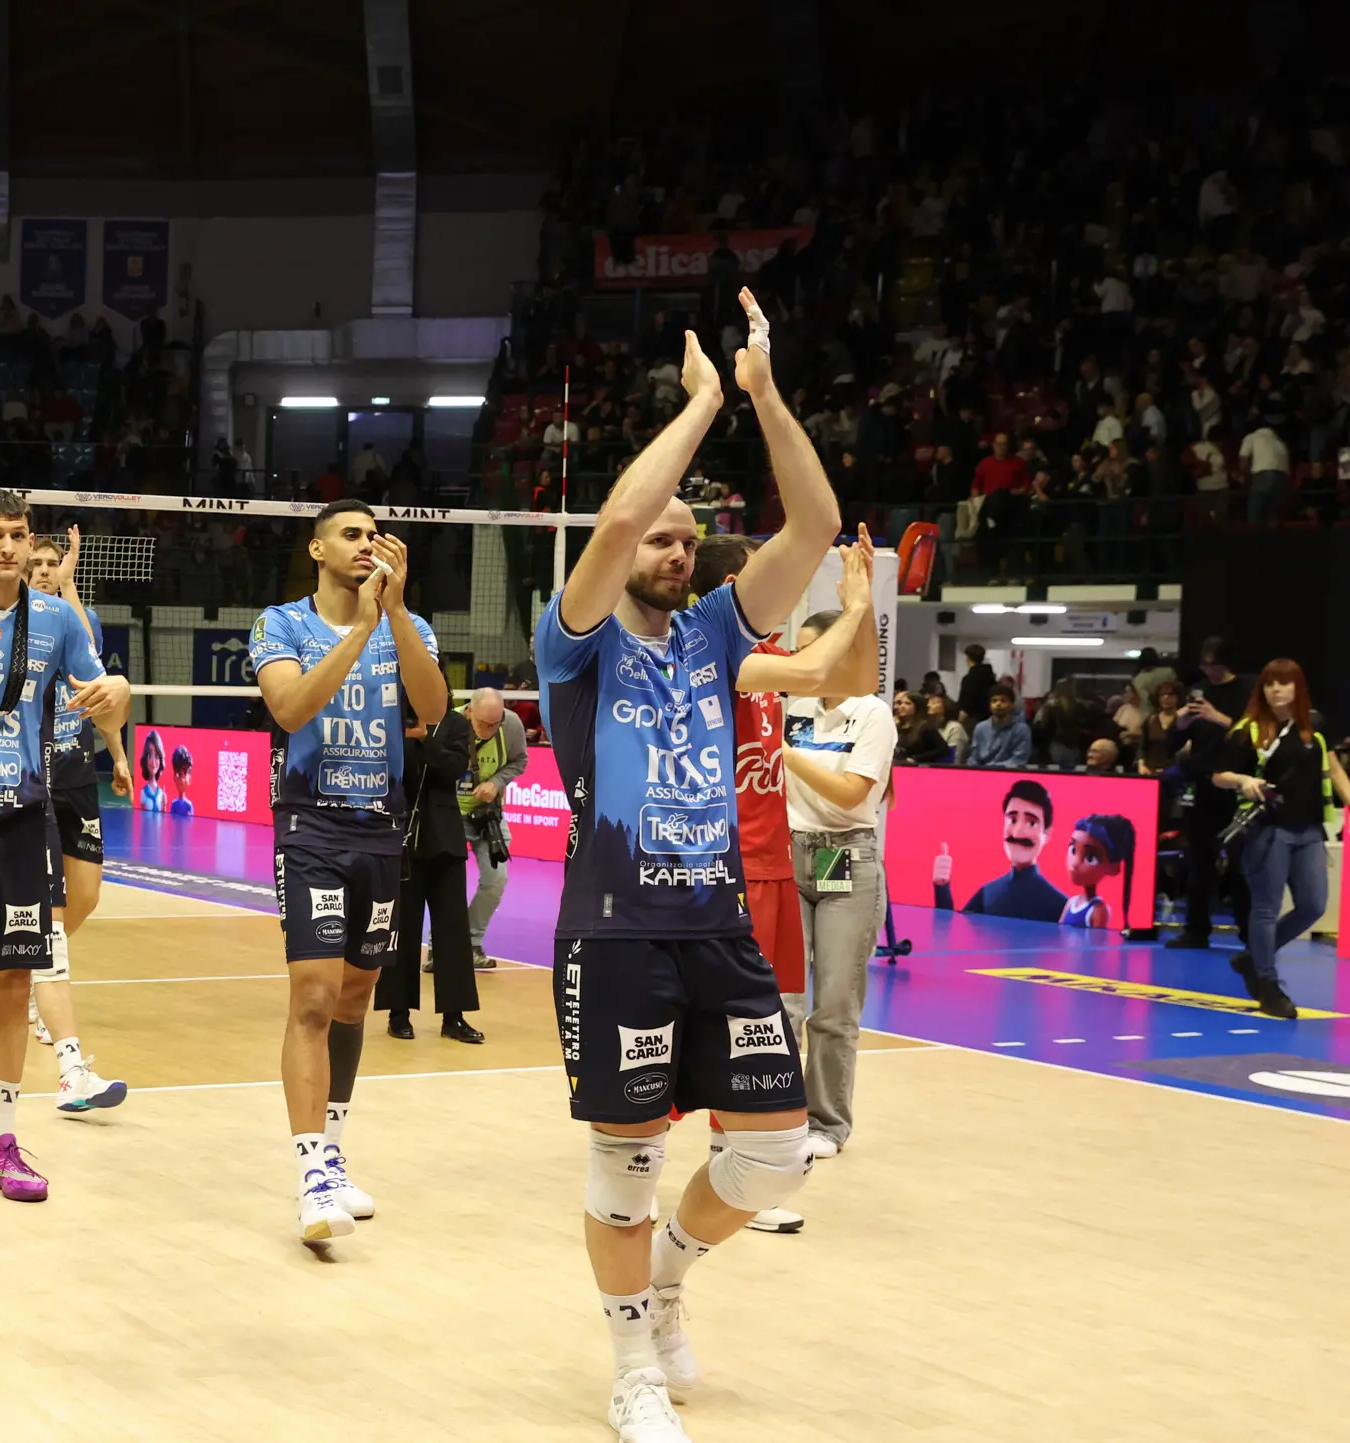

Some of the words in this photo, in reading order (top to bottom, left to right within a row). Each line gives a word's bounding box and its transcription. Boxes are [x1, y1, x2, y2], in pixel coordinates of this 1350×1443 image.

[182, 498, 249, 511] MINT
[388, 507, 450, 520] MINT
[879, 613, 889, 694] BUILDING
[212, 655, 254, 682] ire
[340, 684, 365, 712] 10
[322, 718, 387, 748] ITAS
[670, 713, 688, 745] 6
[645, 742, 722, 790] ITAS
[324, 768, 386, 790] TRENTINO
[523, 813, 532, 825] IN
[533, 814, 560, 827] SPORT
[647, 816, 726, 847] TRENTINO
[639, 860, 737, 887] KARRELL
[818, 881, 845, 892] MEDIA
[321, 894, 339, 903] SAN
[315, 902, 343, 911] CARLO
[13, 910, 33, 919] SAN
[8, 918, 38, 928] CARLO
[572, 1000, 581, 1061] ELETTRO
[741, 1023, 775, 1037] SAN
[635, 1034, 664, 1049] SAN
[736, 1034, 783, 1049] CARLO
[625, 1045, 670, 1061] CARLO
[633, 1081, 664, 1095] MANCUSO
[752, 1071, 795, 1091] NIKY'S
